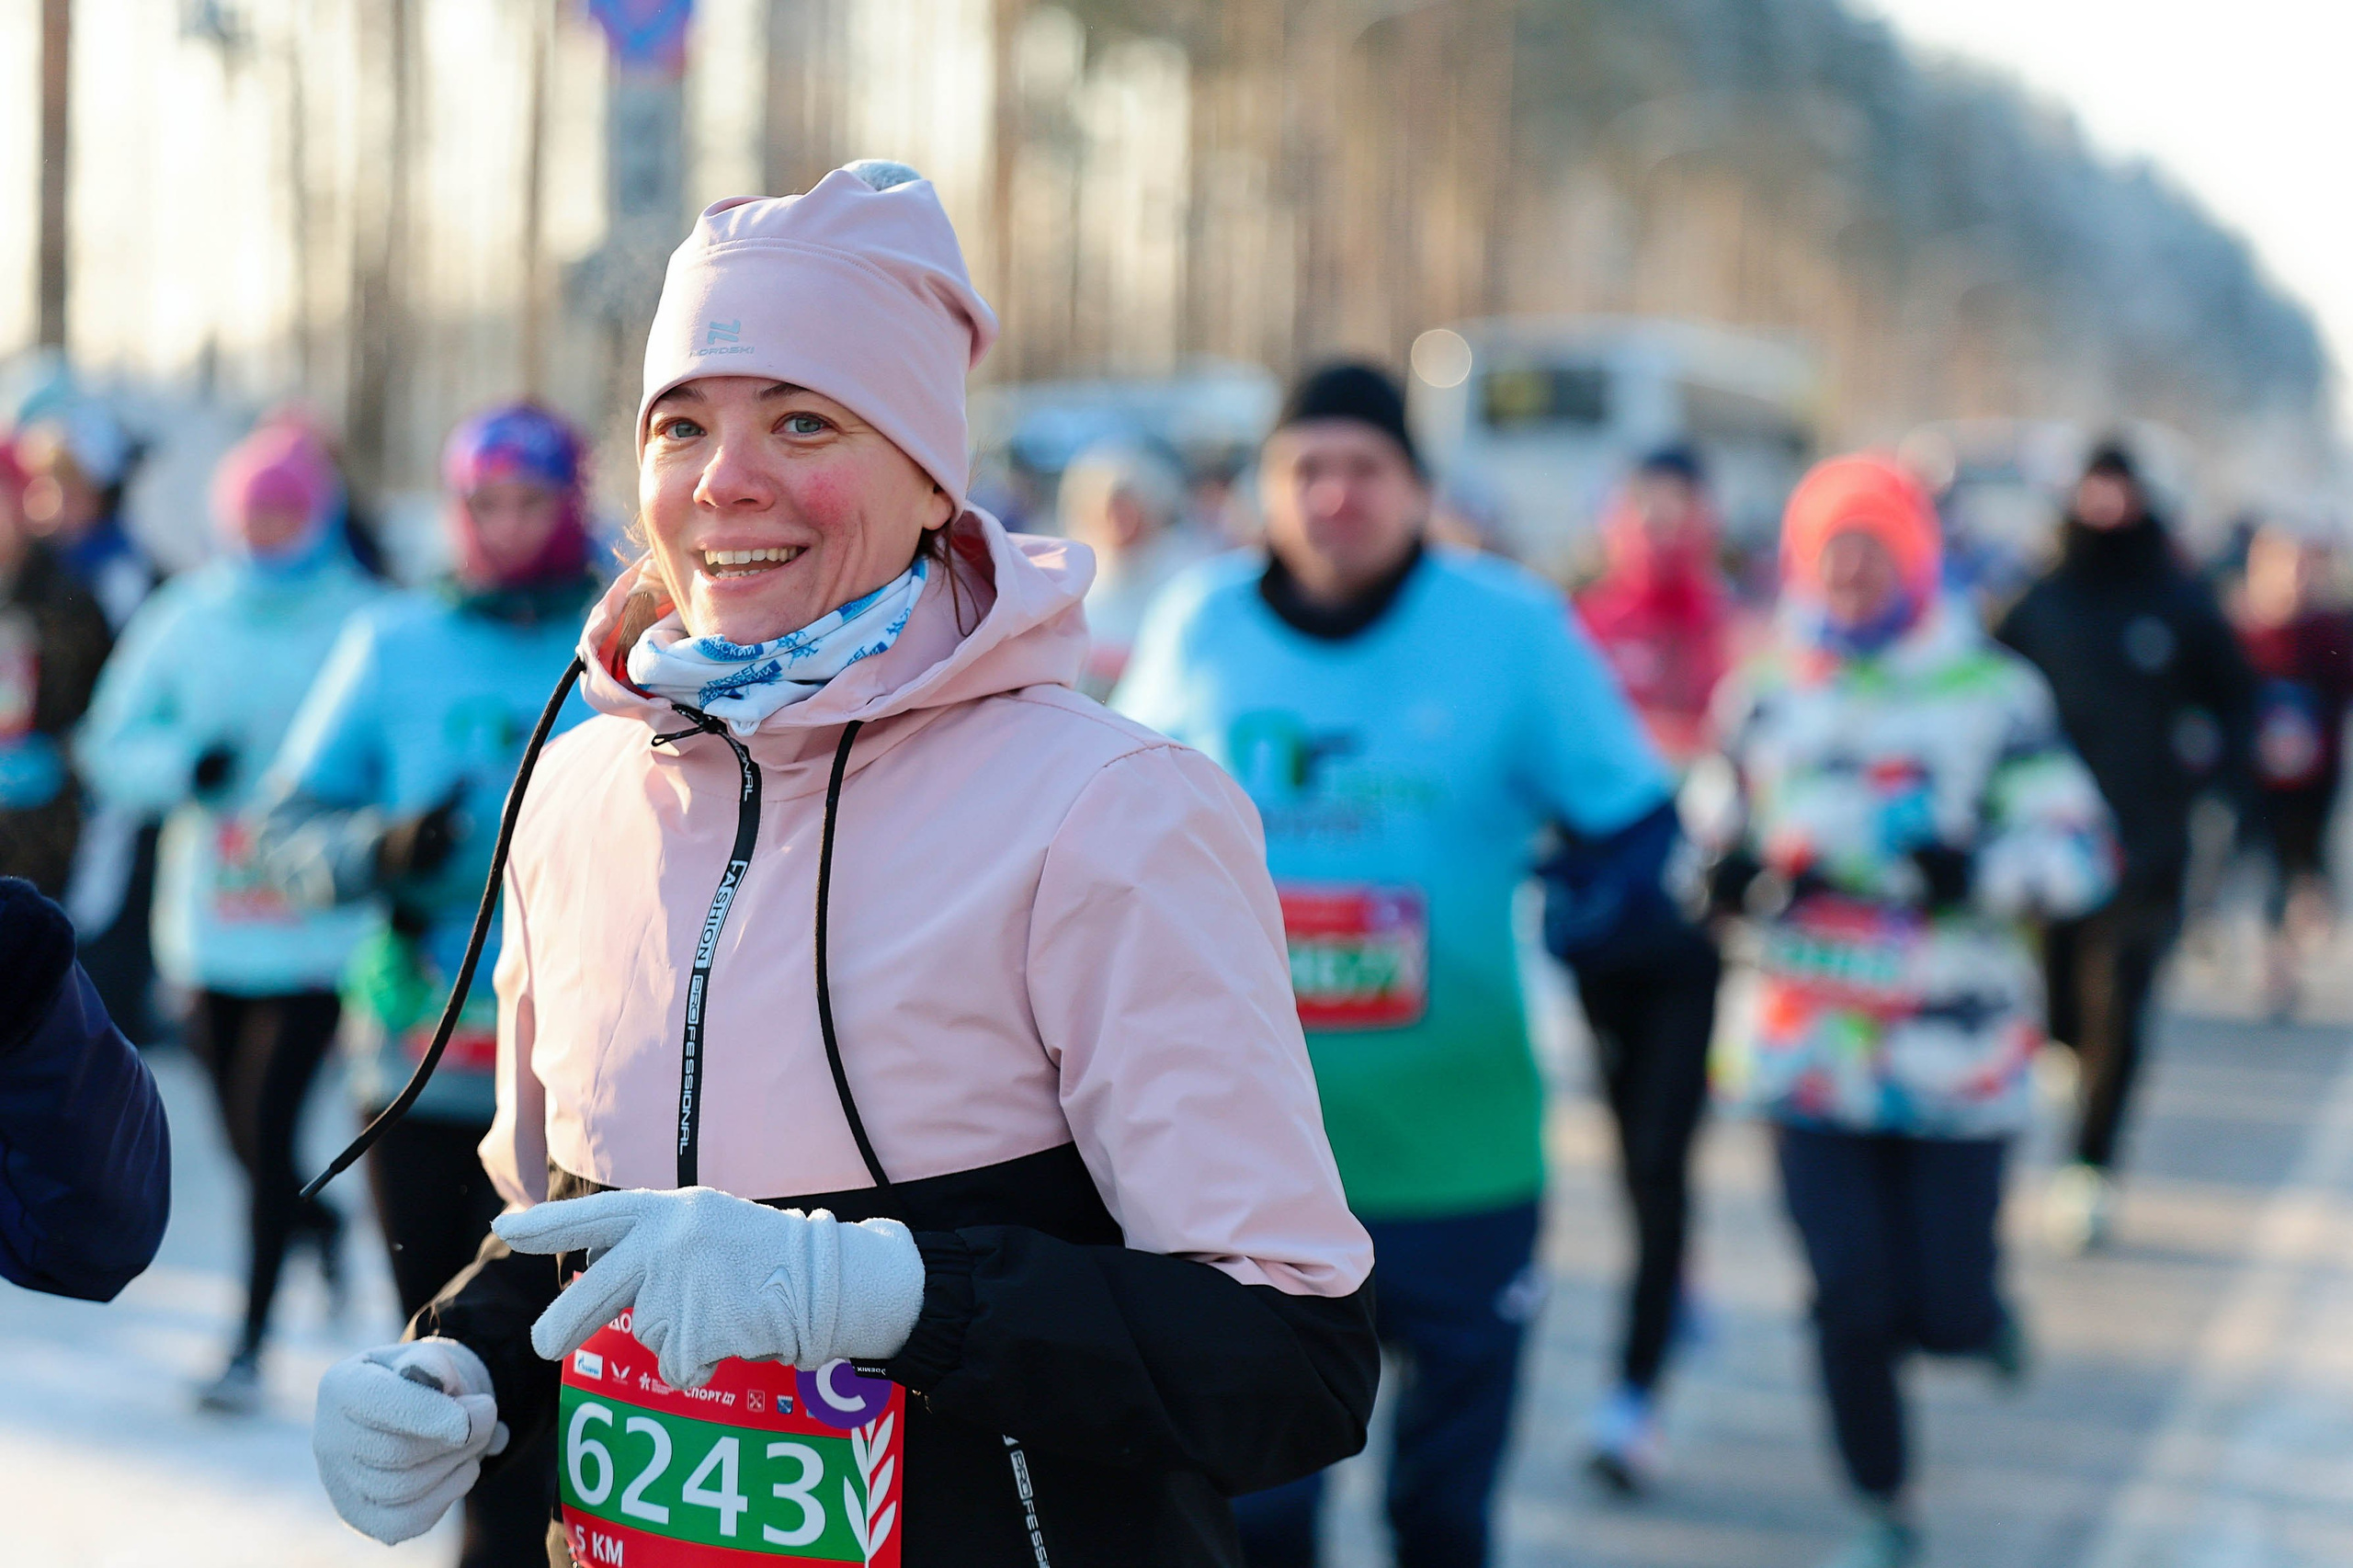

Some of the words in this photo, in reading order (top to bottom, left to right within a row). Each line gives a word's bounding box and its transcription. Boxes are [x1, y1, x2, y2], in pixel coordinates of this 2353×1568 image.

[698, 860, 748, 960] FASHION
[567, 1402, 826, 1546] 6243
[575, 1525, 585, 1552] 5
